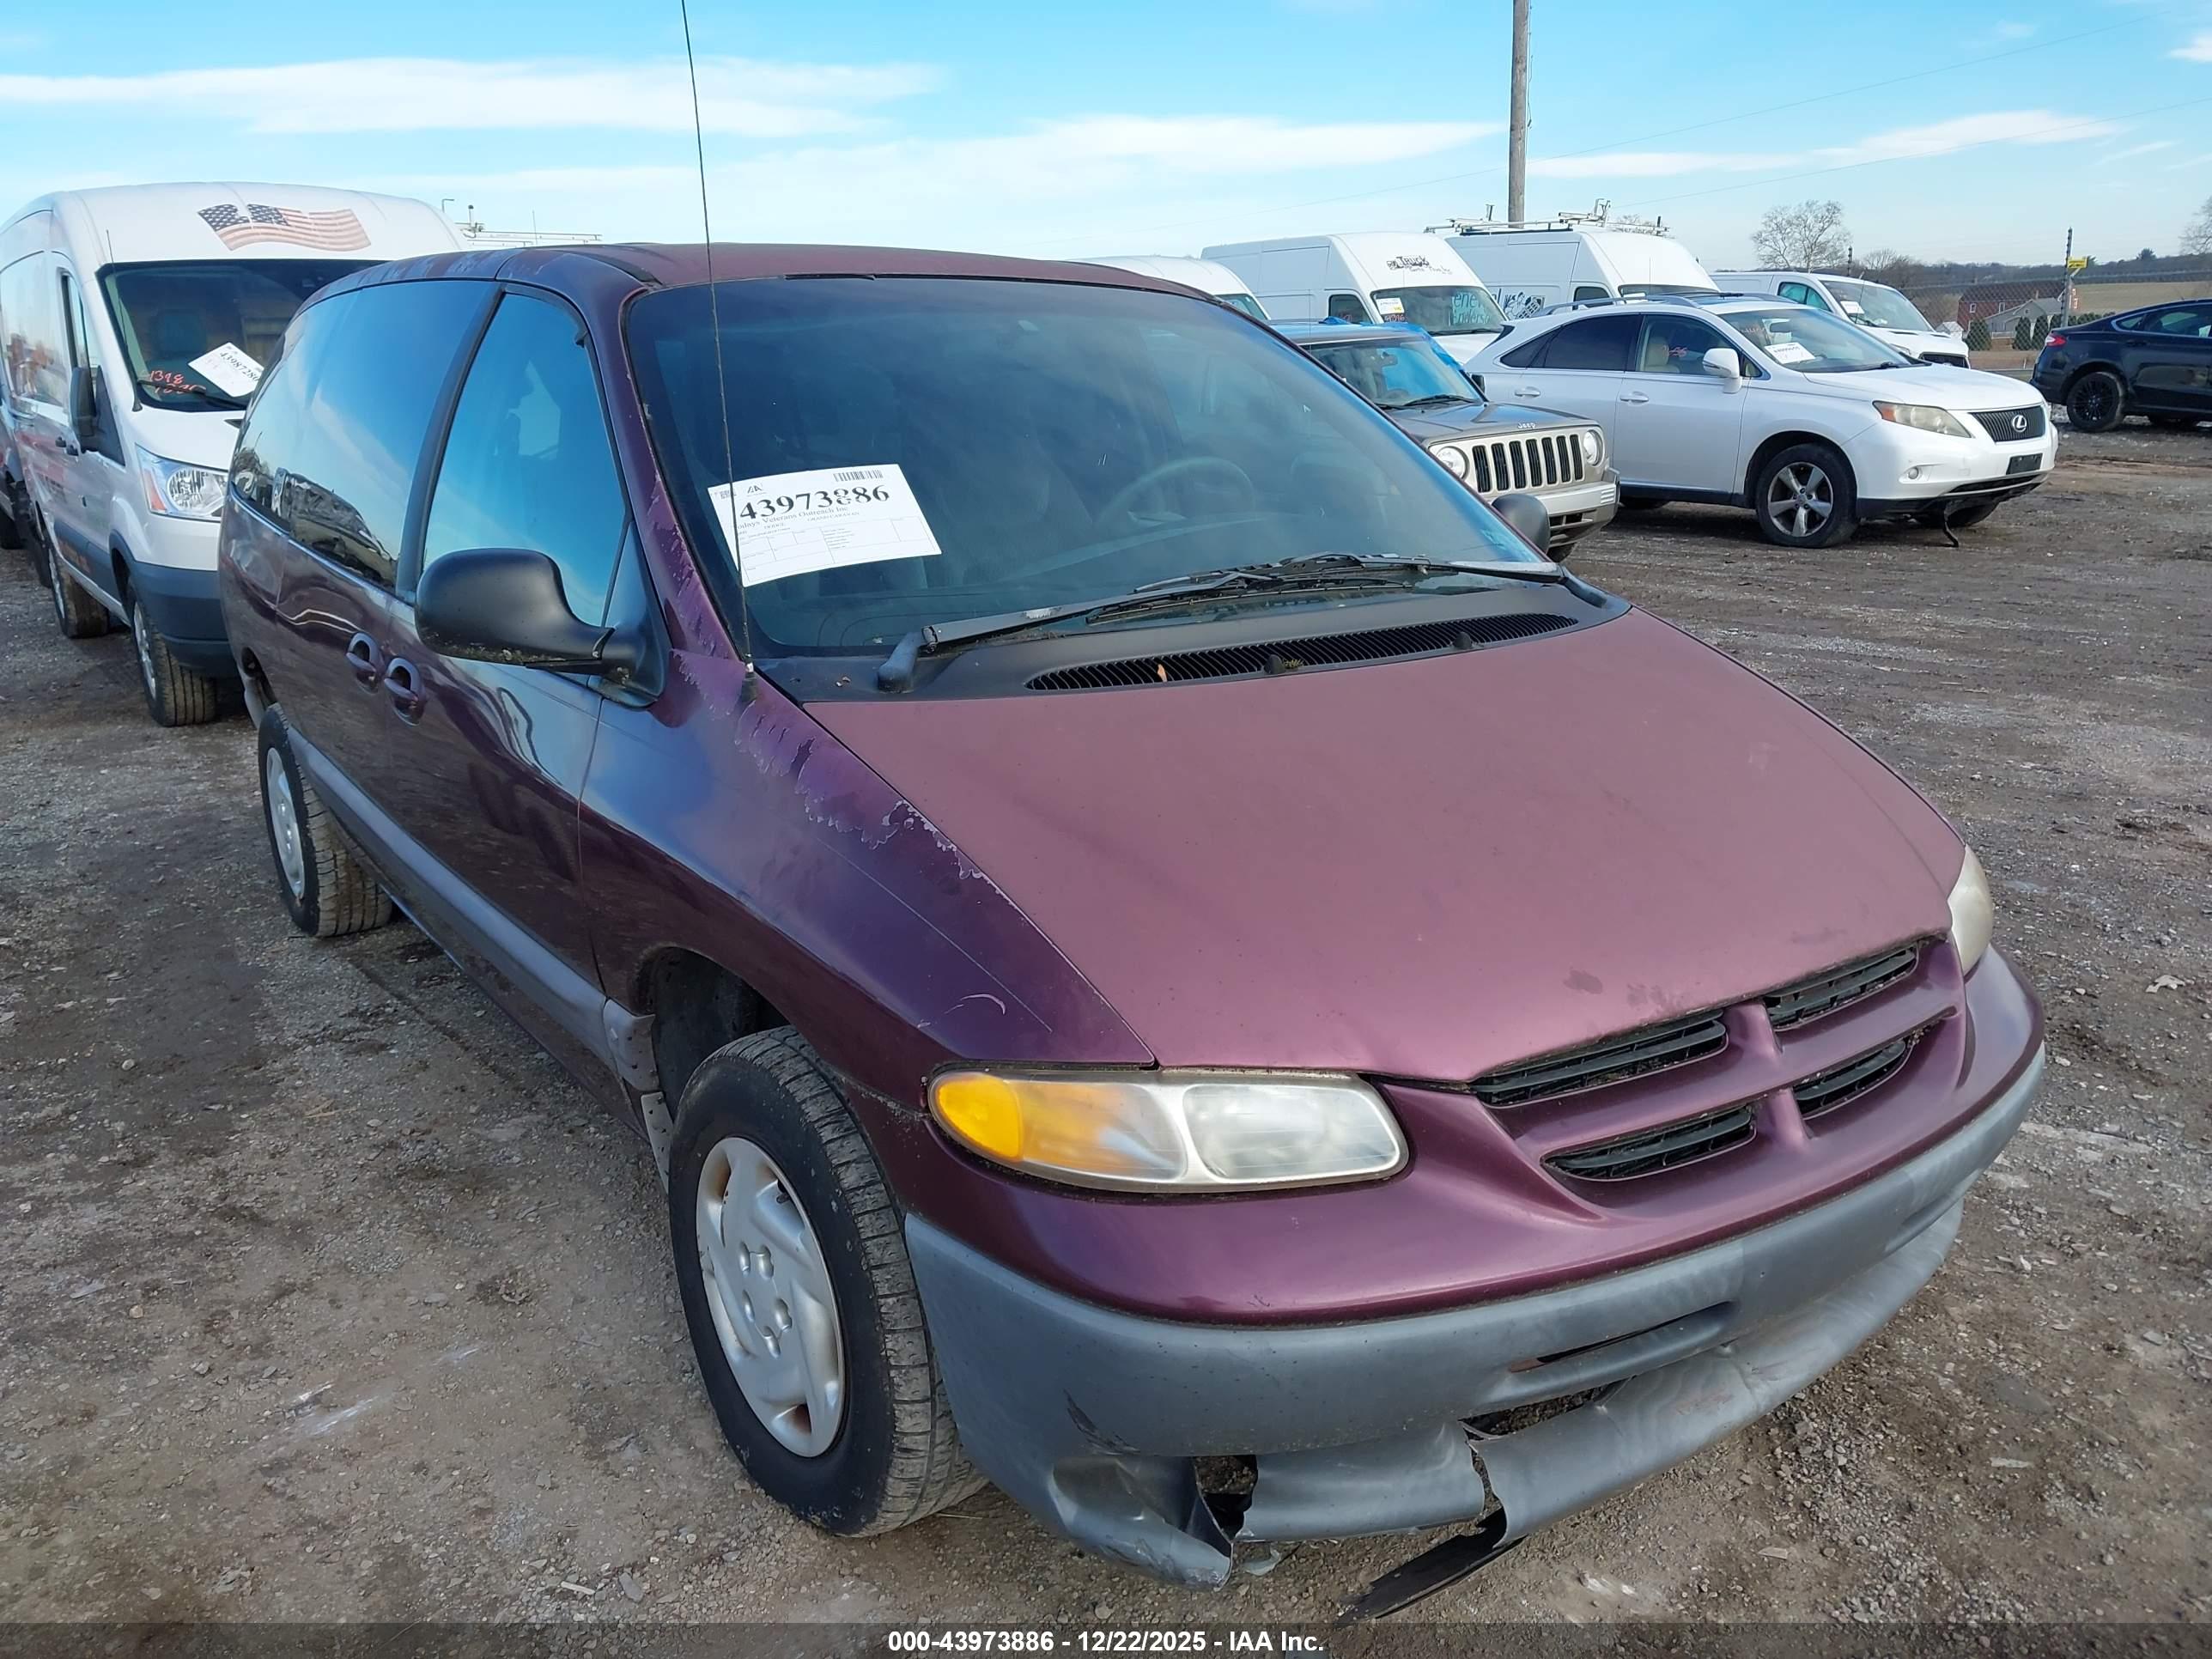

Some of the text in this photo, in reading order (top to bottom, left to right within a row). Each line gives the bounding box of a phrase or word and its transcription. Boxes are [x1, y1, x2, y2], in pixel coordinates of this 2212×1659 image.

[739, 484, 890, 520] 43973886
[762, 514, 797, 523] Veterans
[799, 507, 834, 517] Outreach
